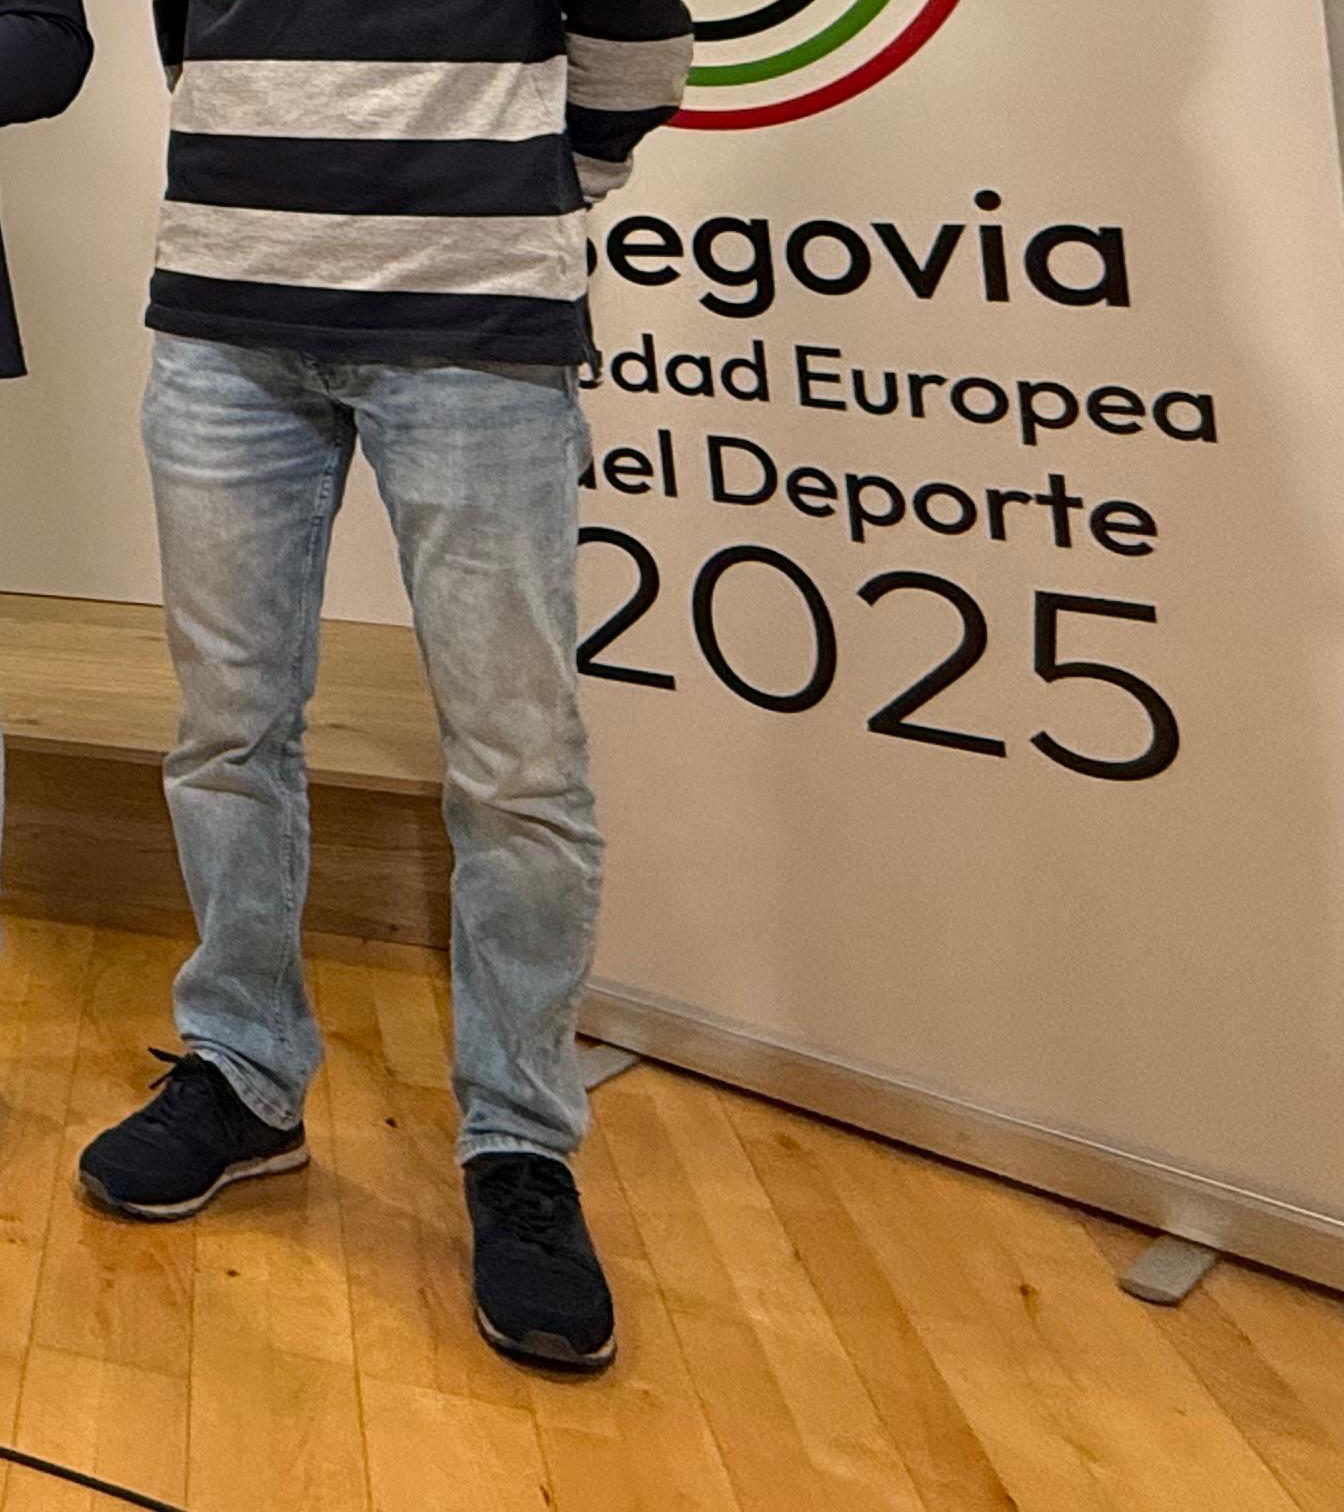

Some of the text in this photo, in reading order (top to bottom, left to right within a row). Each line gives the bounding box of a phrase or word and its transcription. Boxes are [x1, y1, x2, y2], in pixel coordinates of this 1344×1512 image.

[585, 189, 1131, 319] egovia
[794, 344, 1219, 447] Europea
[706, 434, 1159, 558] Deporte
[576, 526, 1181, 782] 2025
